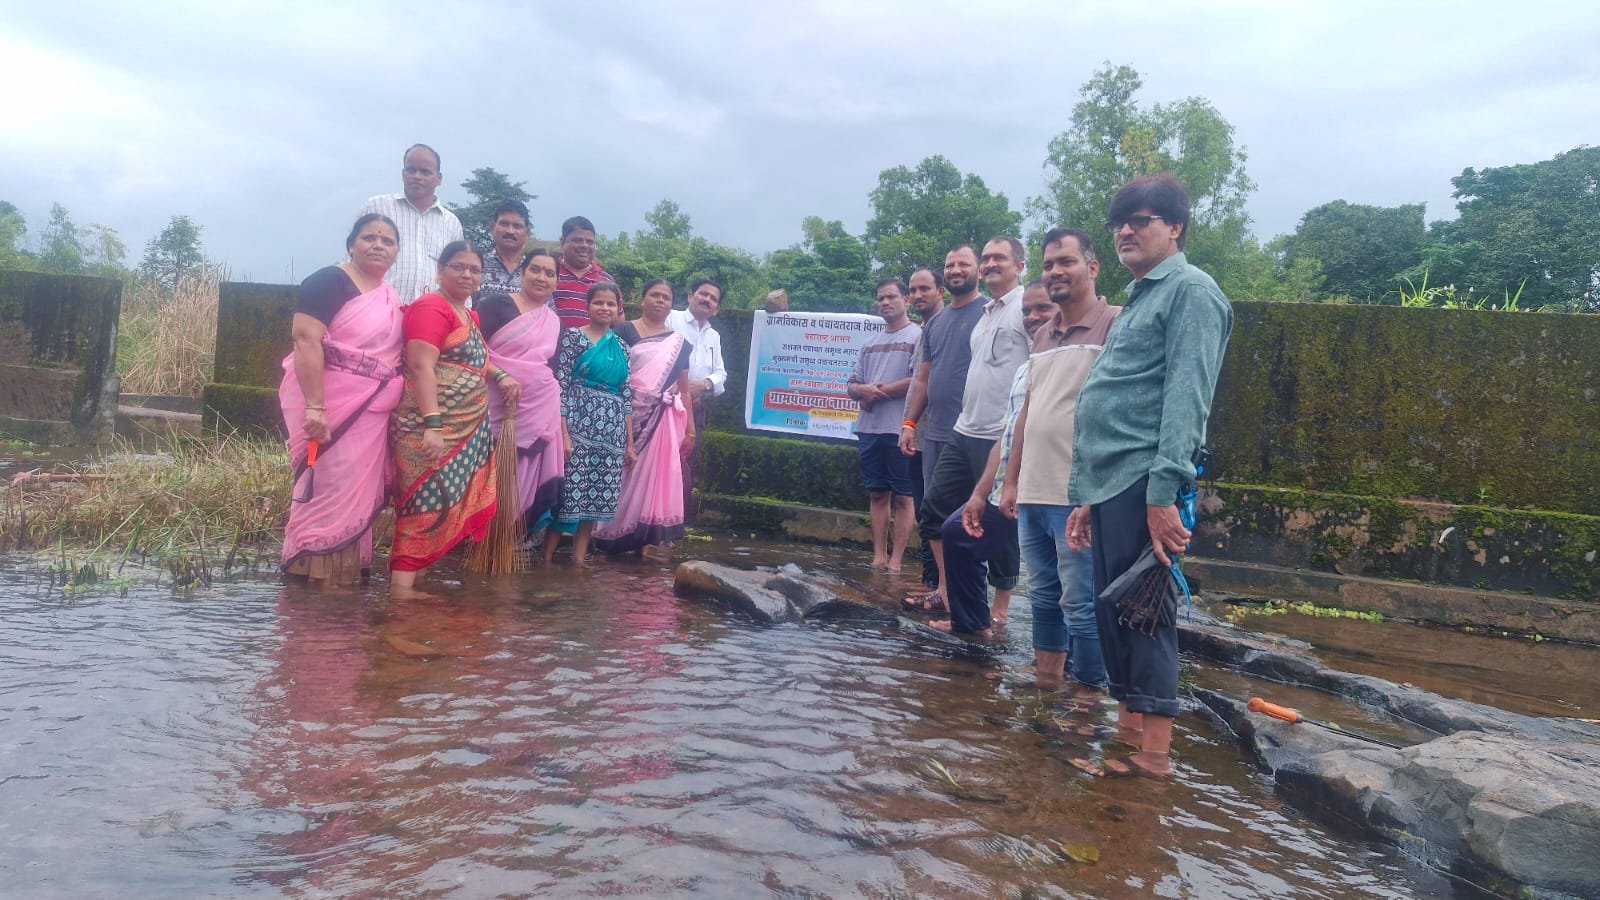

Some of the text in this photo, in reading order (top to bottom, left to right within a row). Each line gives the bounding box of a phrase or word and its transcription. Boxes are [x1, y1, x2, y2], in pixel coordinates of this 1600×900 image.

[767, 314, 808, 328] ग्रामविकास
[811, 319, 816, 328] व
[818, 316, 861, 331] पंचायतराज
[804, 333, 829, 343] महाराष्ट्र
[769, 390, 827, 408] ग्रामपंचायत
